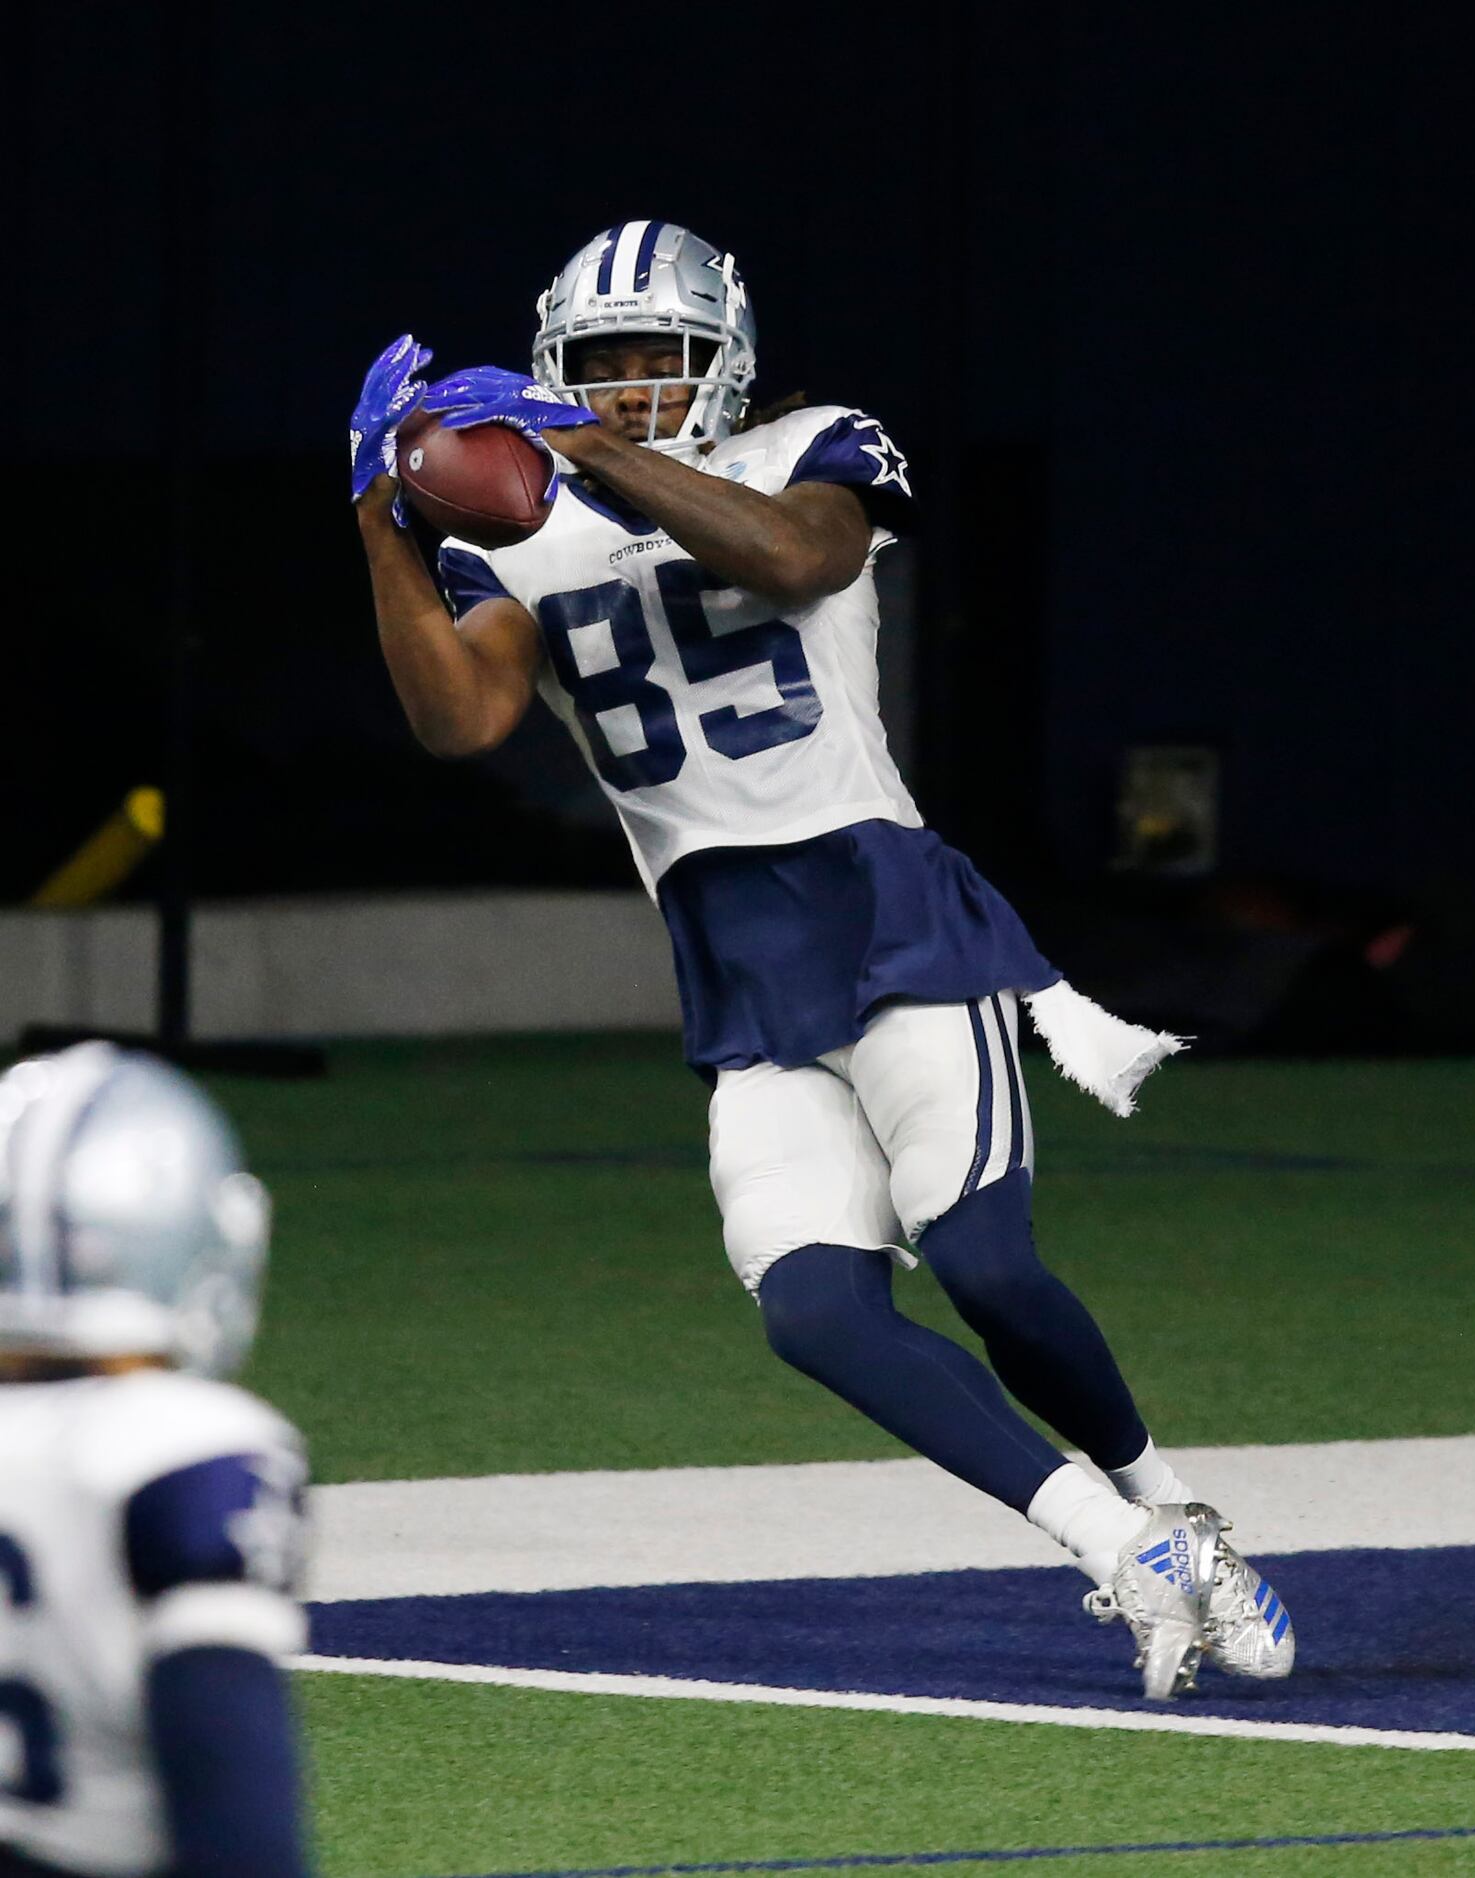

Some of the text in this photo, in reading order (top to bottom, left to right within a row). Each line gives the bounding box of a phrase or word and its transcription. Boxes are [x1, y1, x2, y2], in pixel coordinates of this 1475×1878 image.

[609, 538, 672, 564] COWBOYS
[538, 558, 824, 793] 85
[1173, 1529, 1194, 1595] adidas
